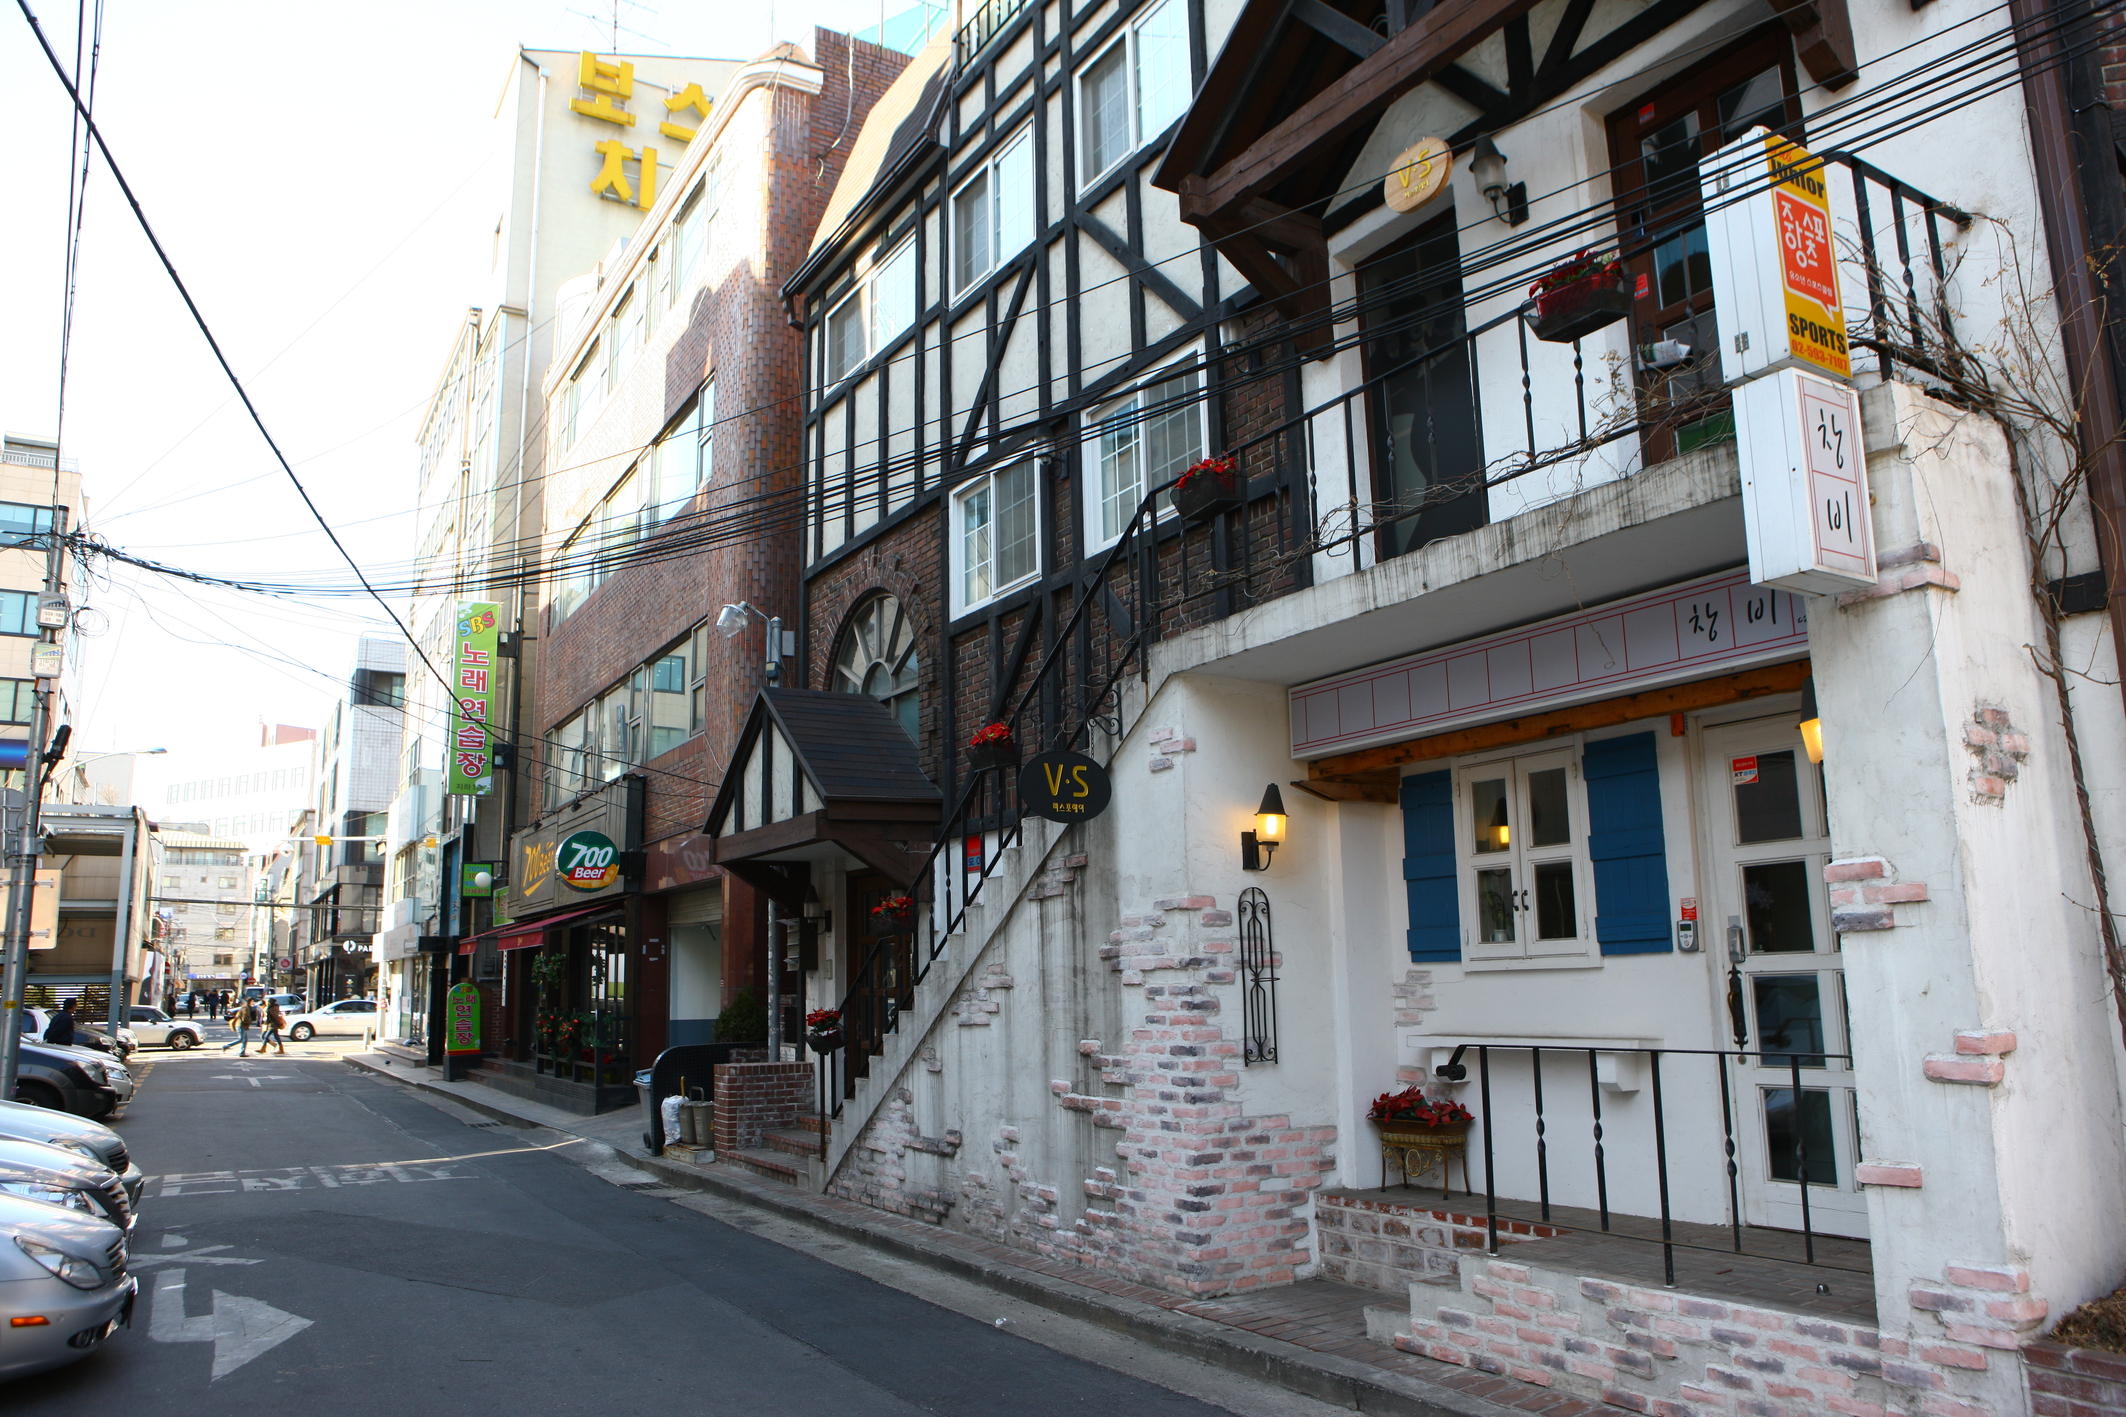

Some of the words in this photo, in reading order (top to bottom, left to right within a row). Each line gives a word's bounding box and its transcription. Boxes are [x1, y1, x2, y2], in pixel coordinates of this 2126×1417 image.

[1802, 211, 1826, 268] 스포츠
[1789, 312, 1847, 355] SPORTS
[1791, 339, 1847, 371] 02-593-7107
[458, 610, 496, 637] SBS
[456, 641, 490, 778] 노래연습장
[566, 842, 614, 869] 700
[574, 867, 606, 879] Beer
[454, 1004, 474, 1045] 연습장
